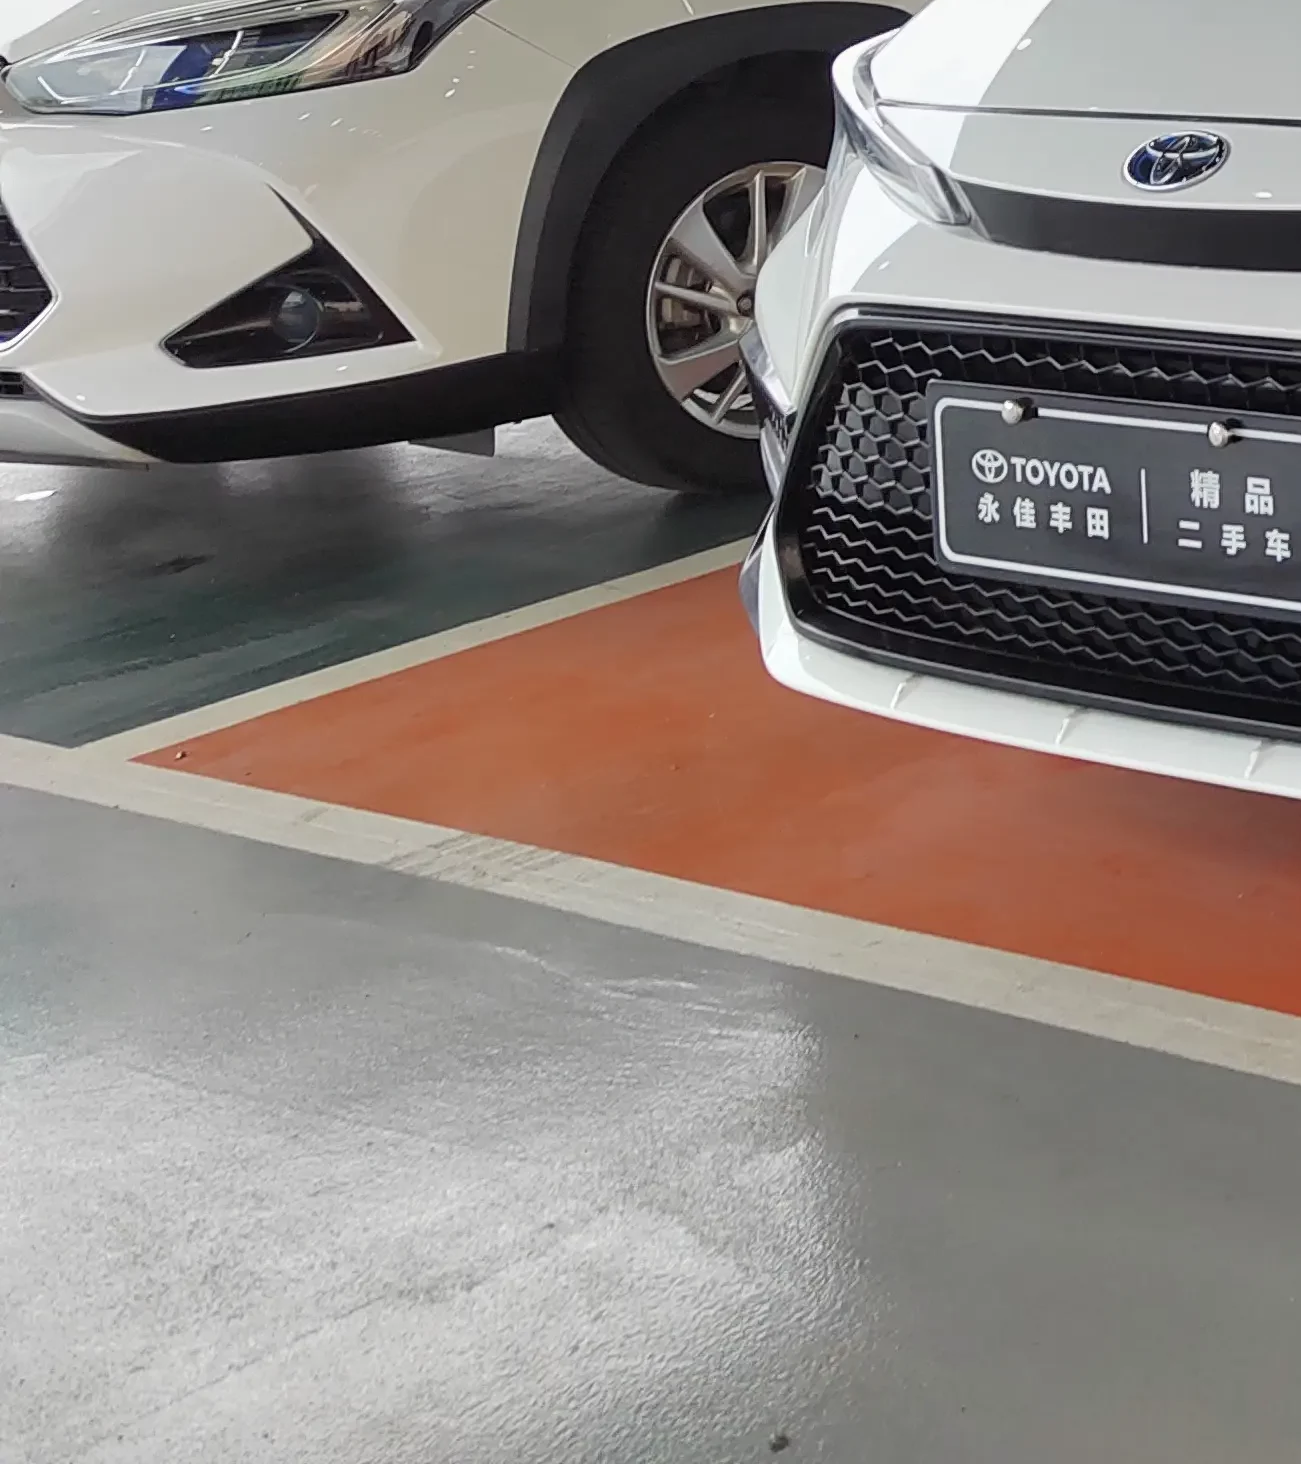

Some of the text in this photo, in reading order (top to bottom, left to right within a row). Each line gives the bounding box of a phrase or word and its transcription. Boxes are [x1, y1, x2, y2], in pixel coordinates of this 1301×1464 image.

[1010, 456, 1112, 494] TOYOTA
[1190, 469, 1274, 516] 精品
[978, 492, 1110, 540] 永佳丰田
[1178, 520, 1291, 562] 二手车
